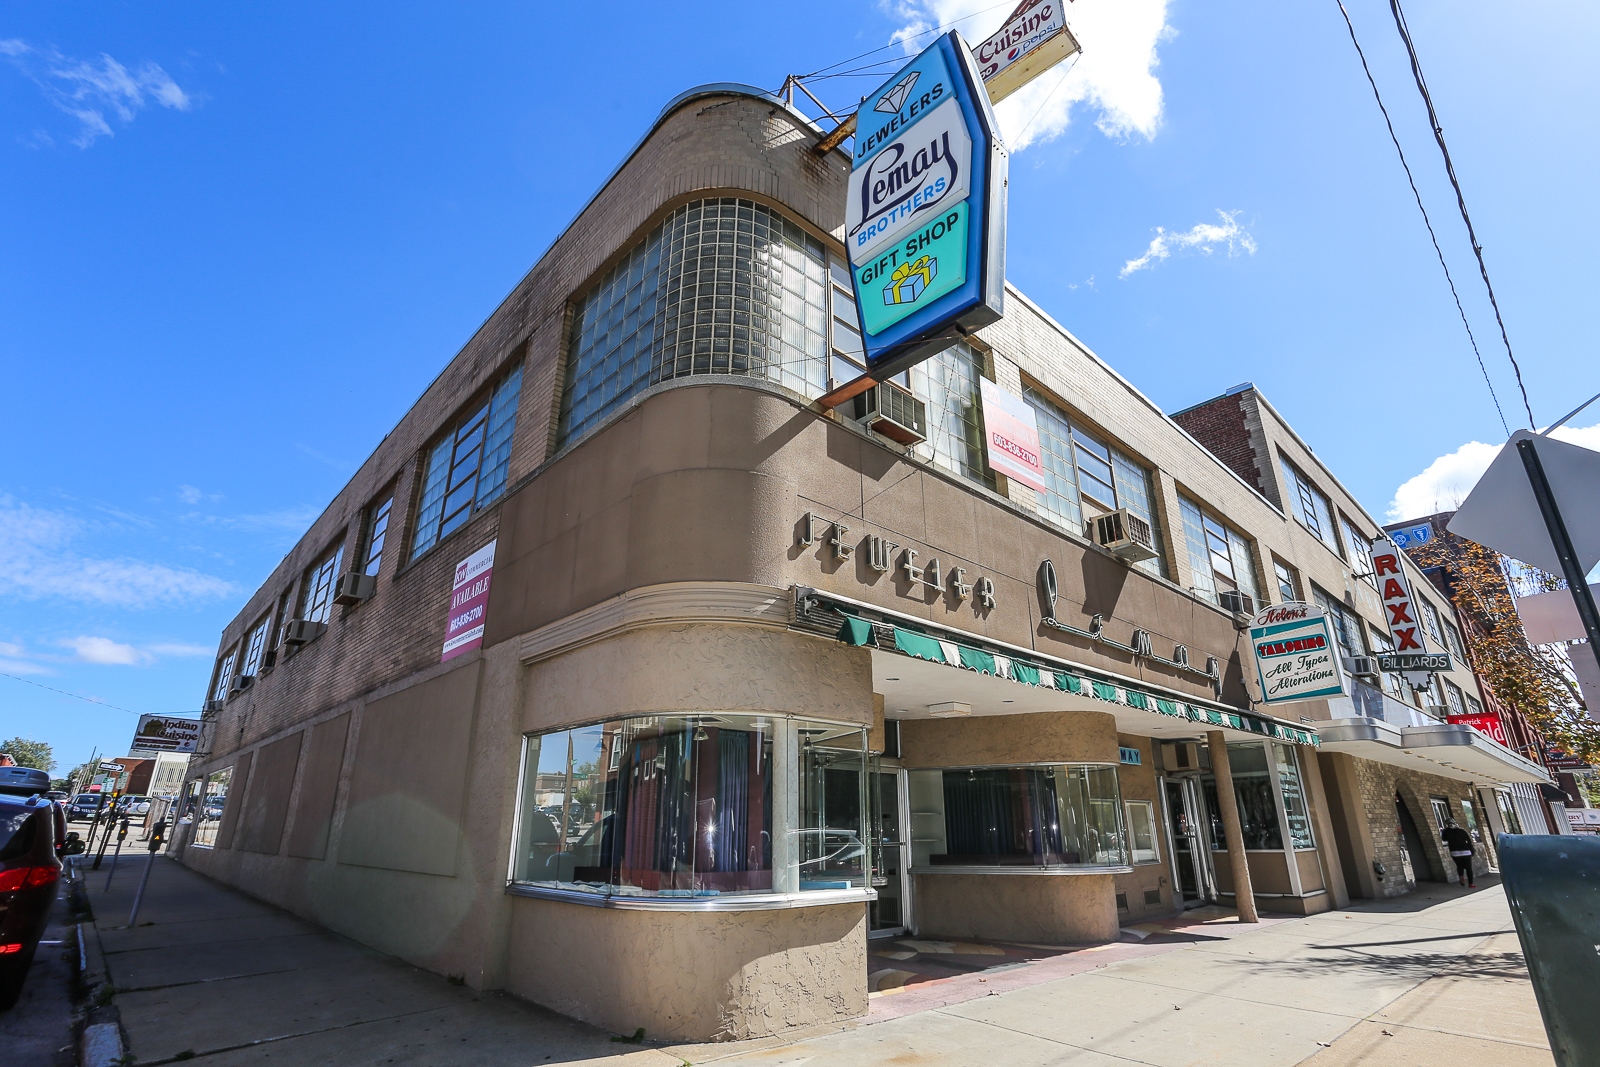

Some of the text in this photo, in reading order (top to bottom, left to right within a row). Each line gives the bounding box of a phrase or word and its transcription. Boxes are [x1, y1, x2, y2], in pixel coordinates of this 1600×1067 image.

[979, 5, 1053, 64] Cuisine
[1022, 21, 1056, 51] pepsi
[857, 82, 944, 159] JEWELERS
[849, 130, 959, 238] Lemay
[857, 176, 947, 247] BROTHERS
[861, 211, 959, 286] GIFT SHOP
[993, 433, 1038, 467] 603-836-2700
[451, 575, 490, 610] AVAILABLE
[1373, 553, 1422, 652] RAXX
[1258, 635, 1326, 657] TAILORING
[1265, 654, 1329, 678] All Types
[1382, 656, 1448, 669] BILLIARDS
[1268, 669, 1334, 694] Alterations
[157, 729, 198, 741] Cuisine
[163, 718, 198, 732] Indian
[1120, 749, 1139, 763] MAY
